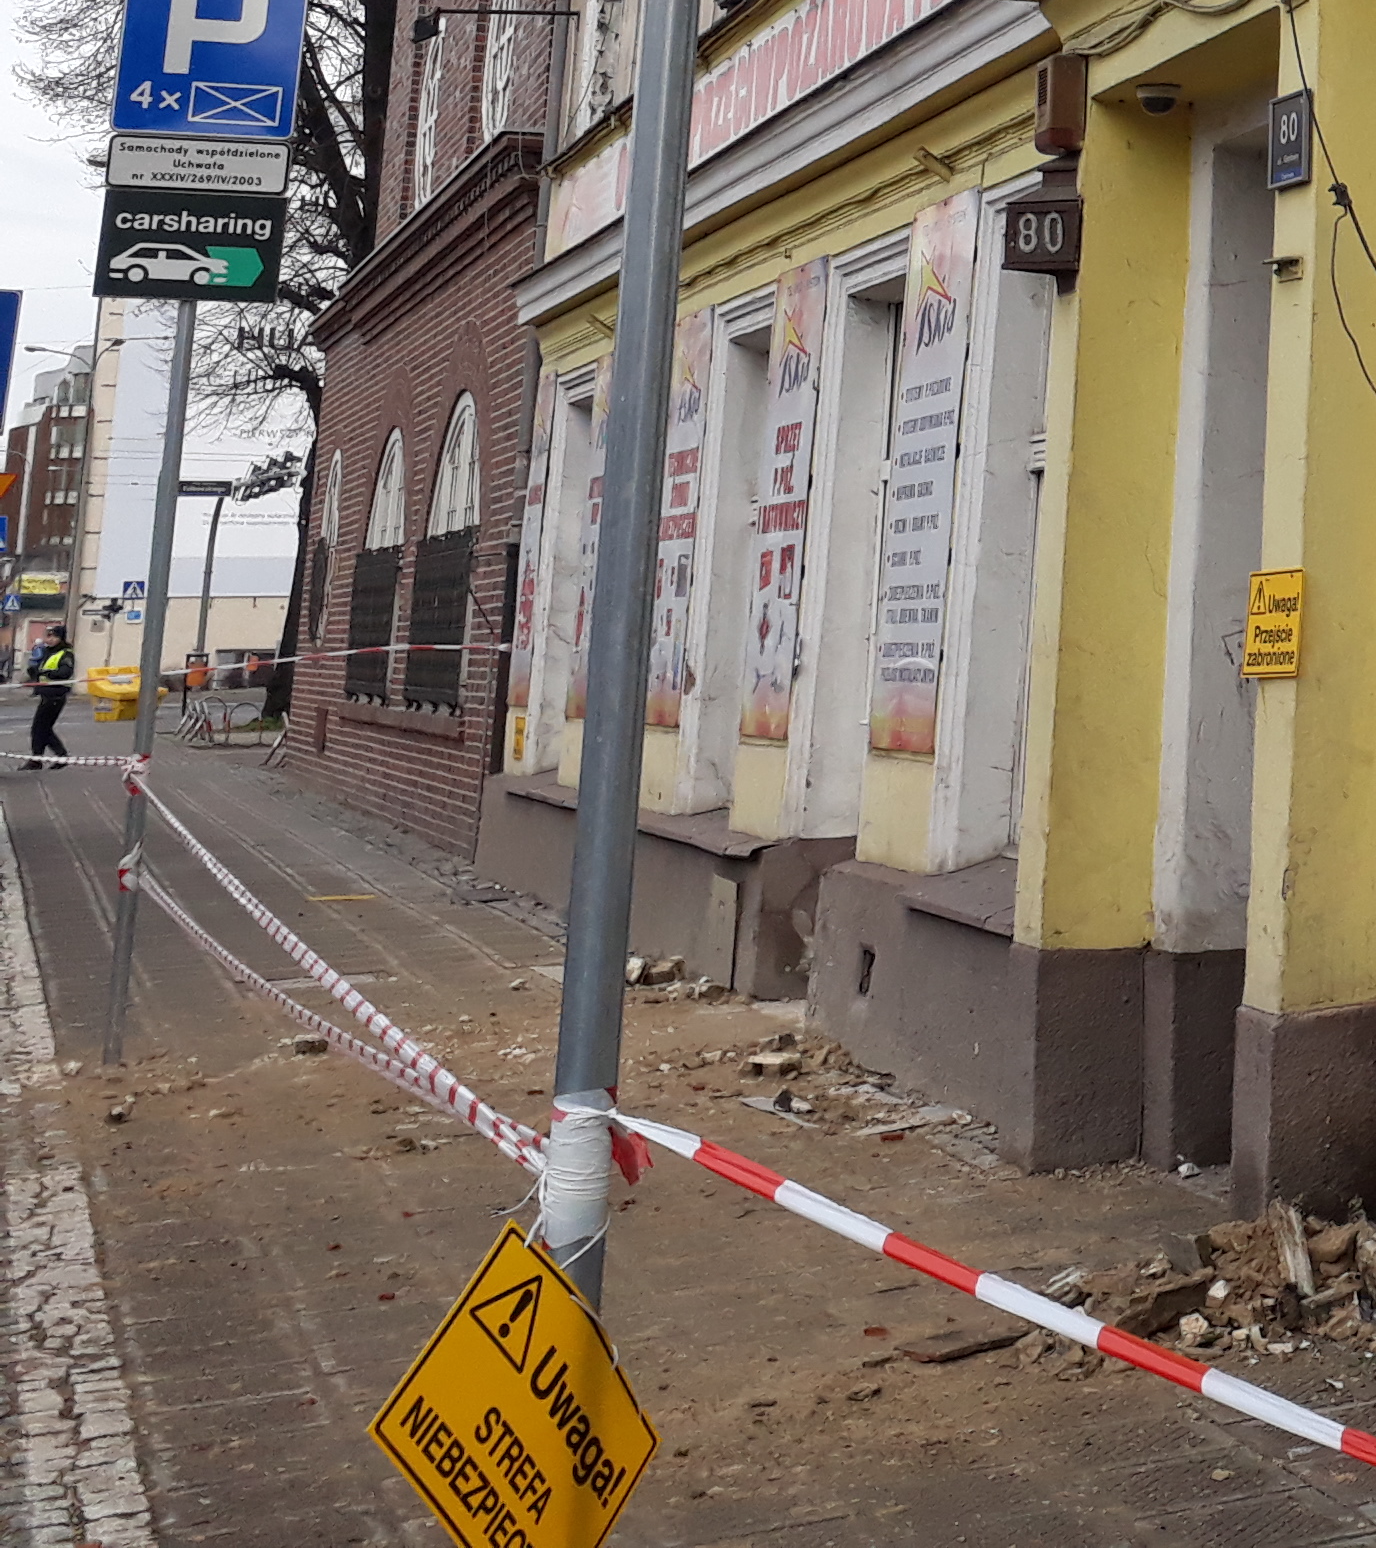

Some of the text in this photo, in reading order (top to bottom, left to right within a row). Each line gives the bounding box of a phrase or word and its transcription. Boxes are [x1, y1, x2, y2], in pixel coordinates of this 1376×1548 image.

[1280, 111, 1298, 145] 80
[118, 142, 282, 159] Samochody współdzielone
[131, 171, 262, 186] nr XXXIV/269/IV/2003
[115, 210, 273, 240] carsharing
[1018, 210, 1064, 253] 80
[1268, 592, 1300, 617] Uwaga!
[1254, 624, 1294, 649] Przejście
[1246, 647, 1295, 667] zabronione
[530, 1345, 627, 1510] Uwaga!
[400, 1395, 535, 1548] NIEBEZPIEC
[474, 1406, 552, 1526] STREFA
